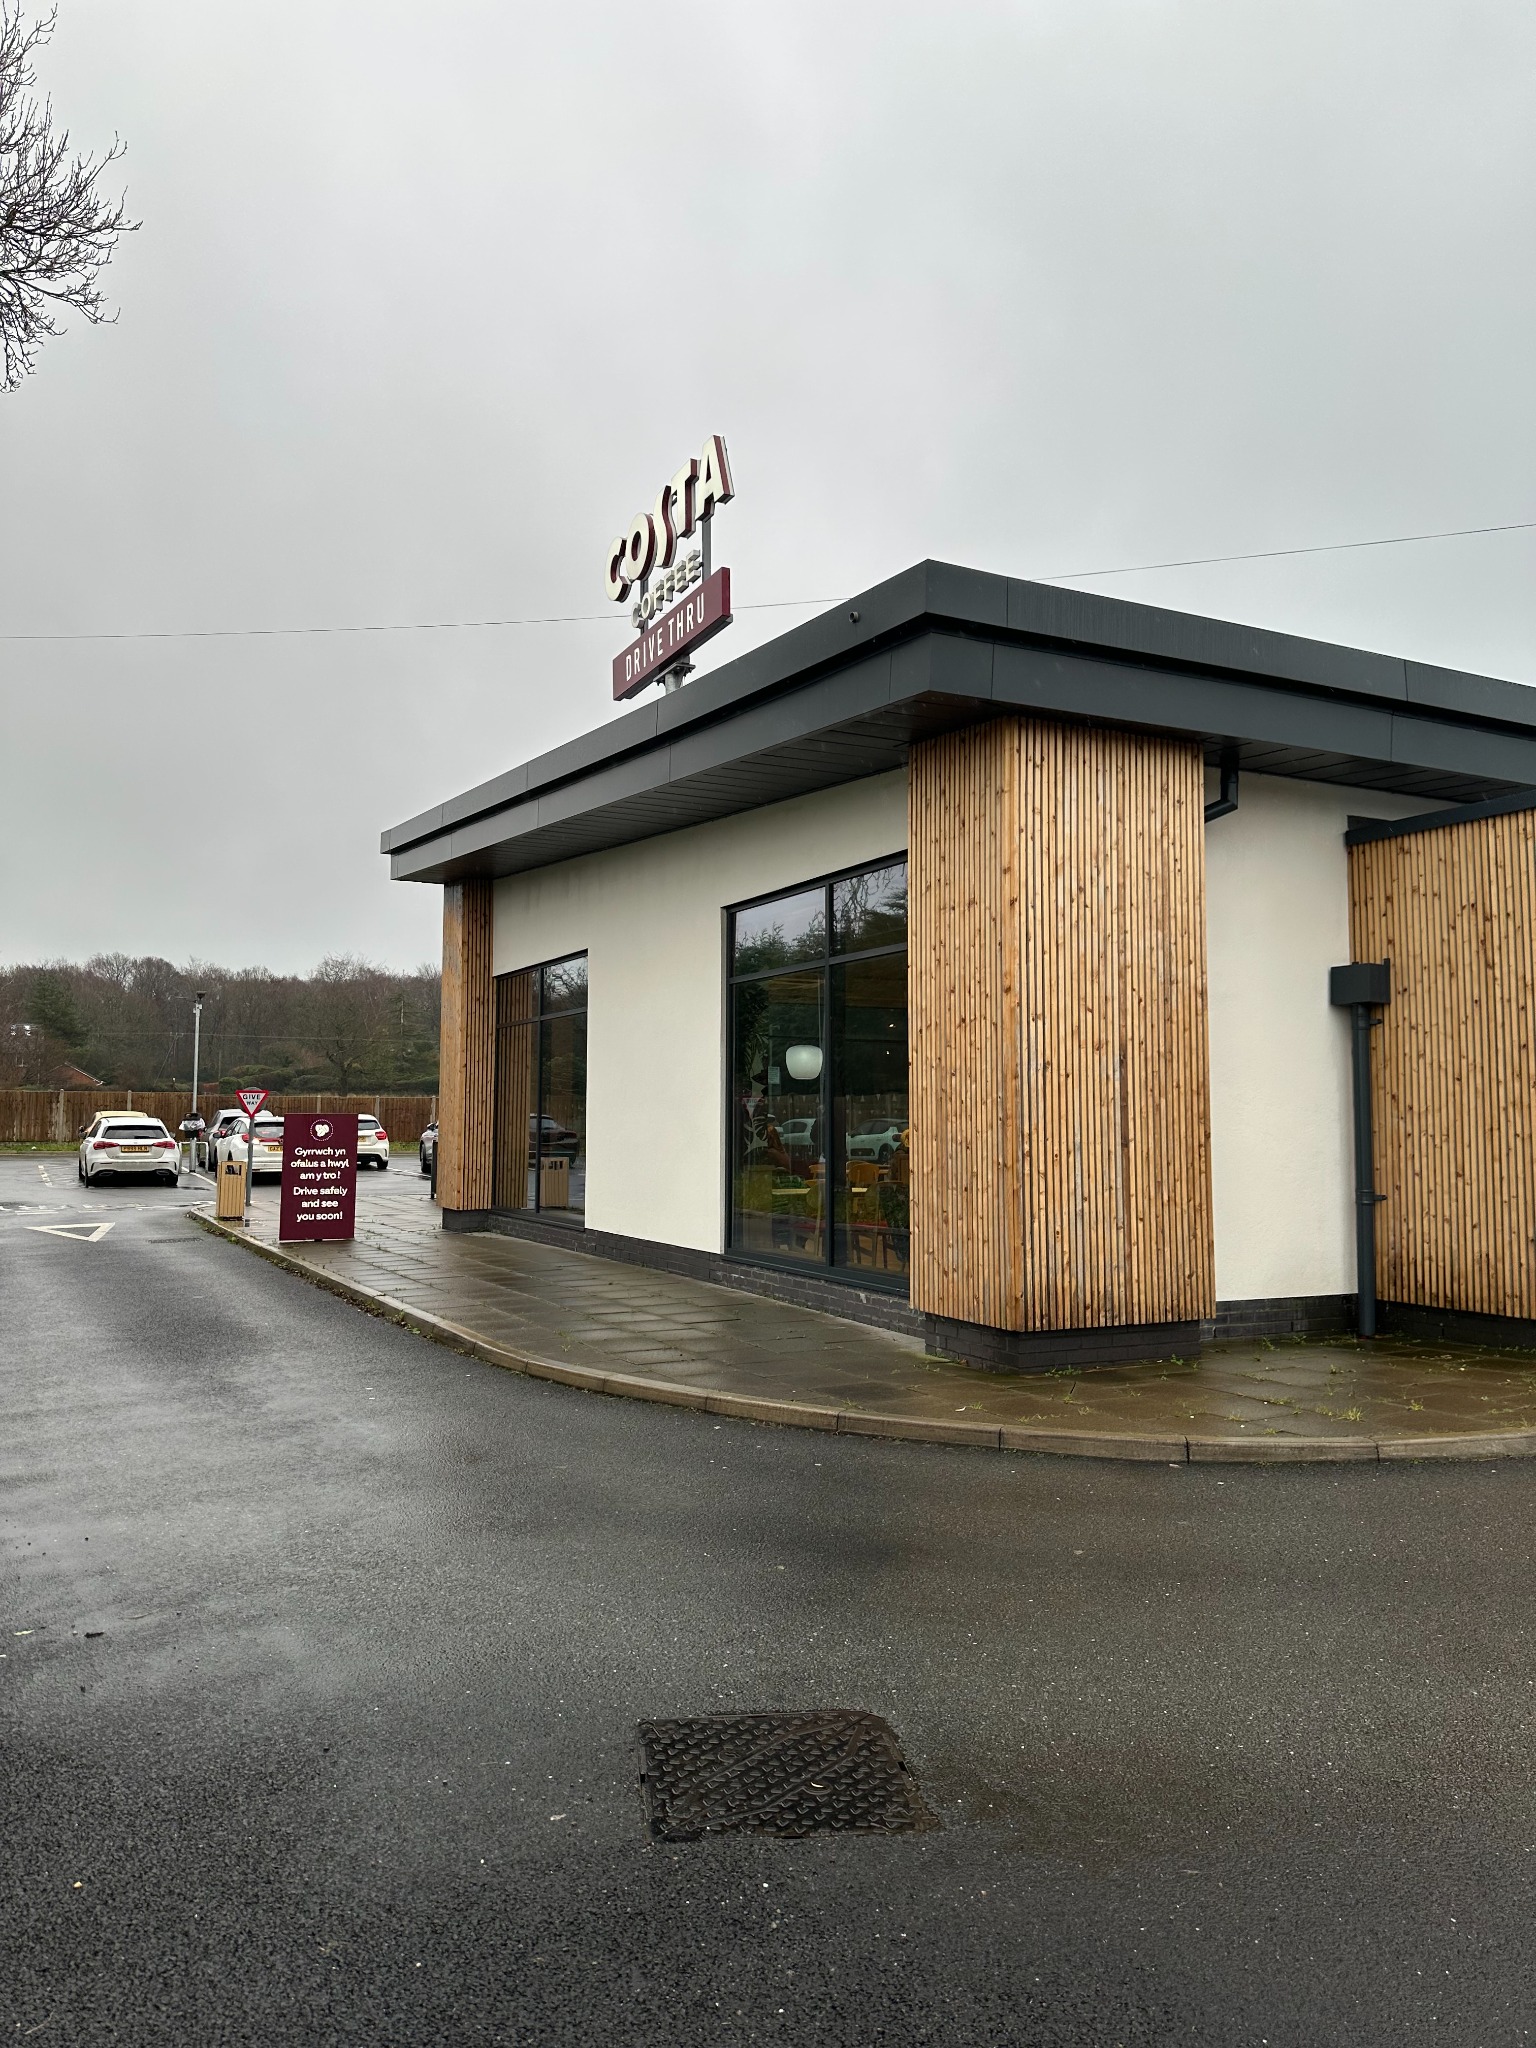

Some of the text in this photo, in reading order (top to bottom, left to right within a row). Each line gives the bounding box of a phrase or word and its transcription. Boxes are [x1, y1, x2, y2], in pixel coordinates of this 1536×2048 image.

[605, 435, 735, 603] COSTA
[631, 549, 701, 629] COFFEE
[626, 592, 704, 681] DRIVE THRU
[295, 1147, 345, 1157] Gyrrwch yn
[291, 1159, 319, 1168] ofalus
[328, 1159, 349, 1168] hwyl
[316, 1173, 322, 1181] y
[294, 1186, 347, 1196] Drive safely
[301, 1199, 320, 1207] and
[297, 1211, 342, 1222] you soon!
